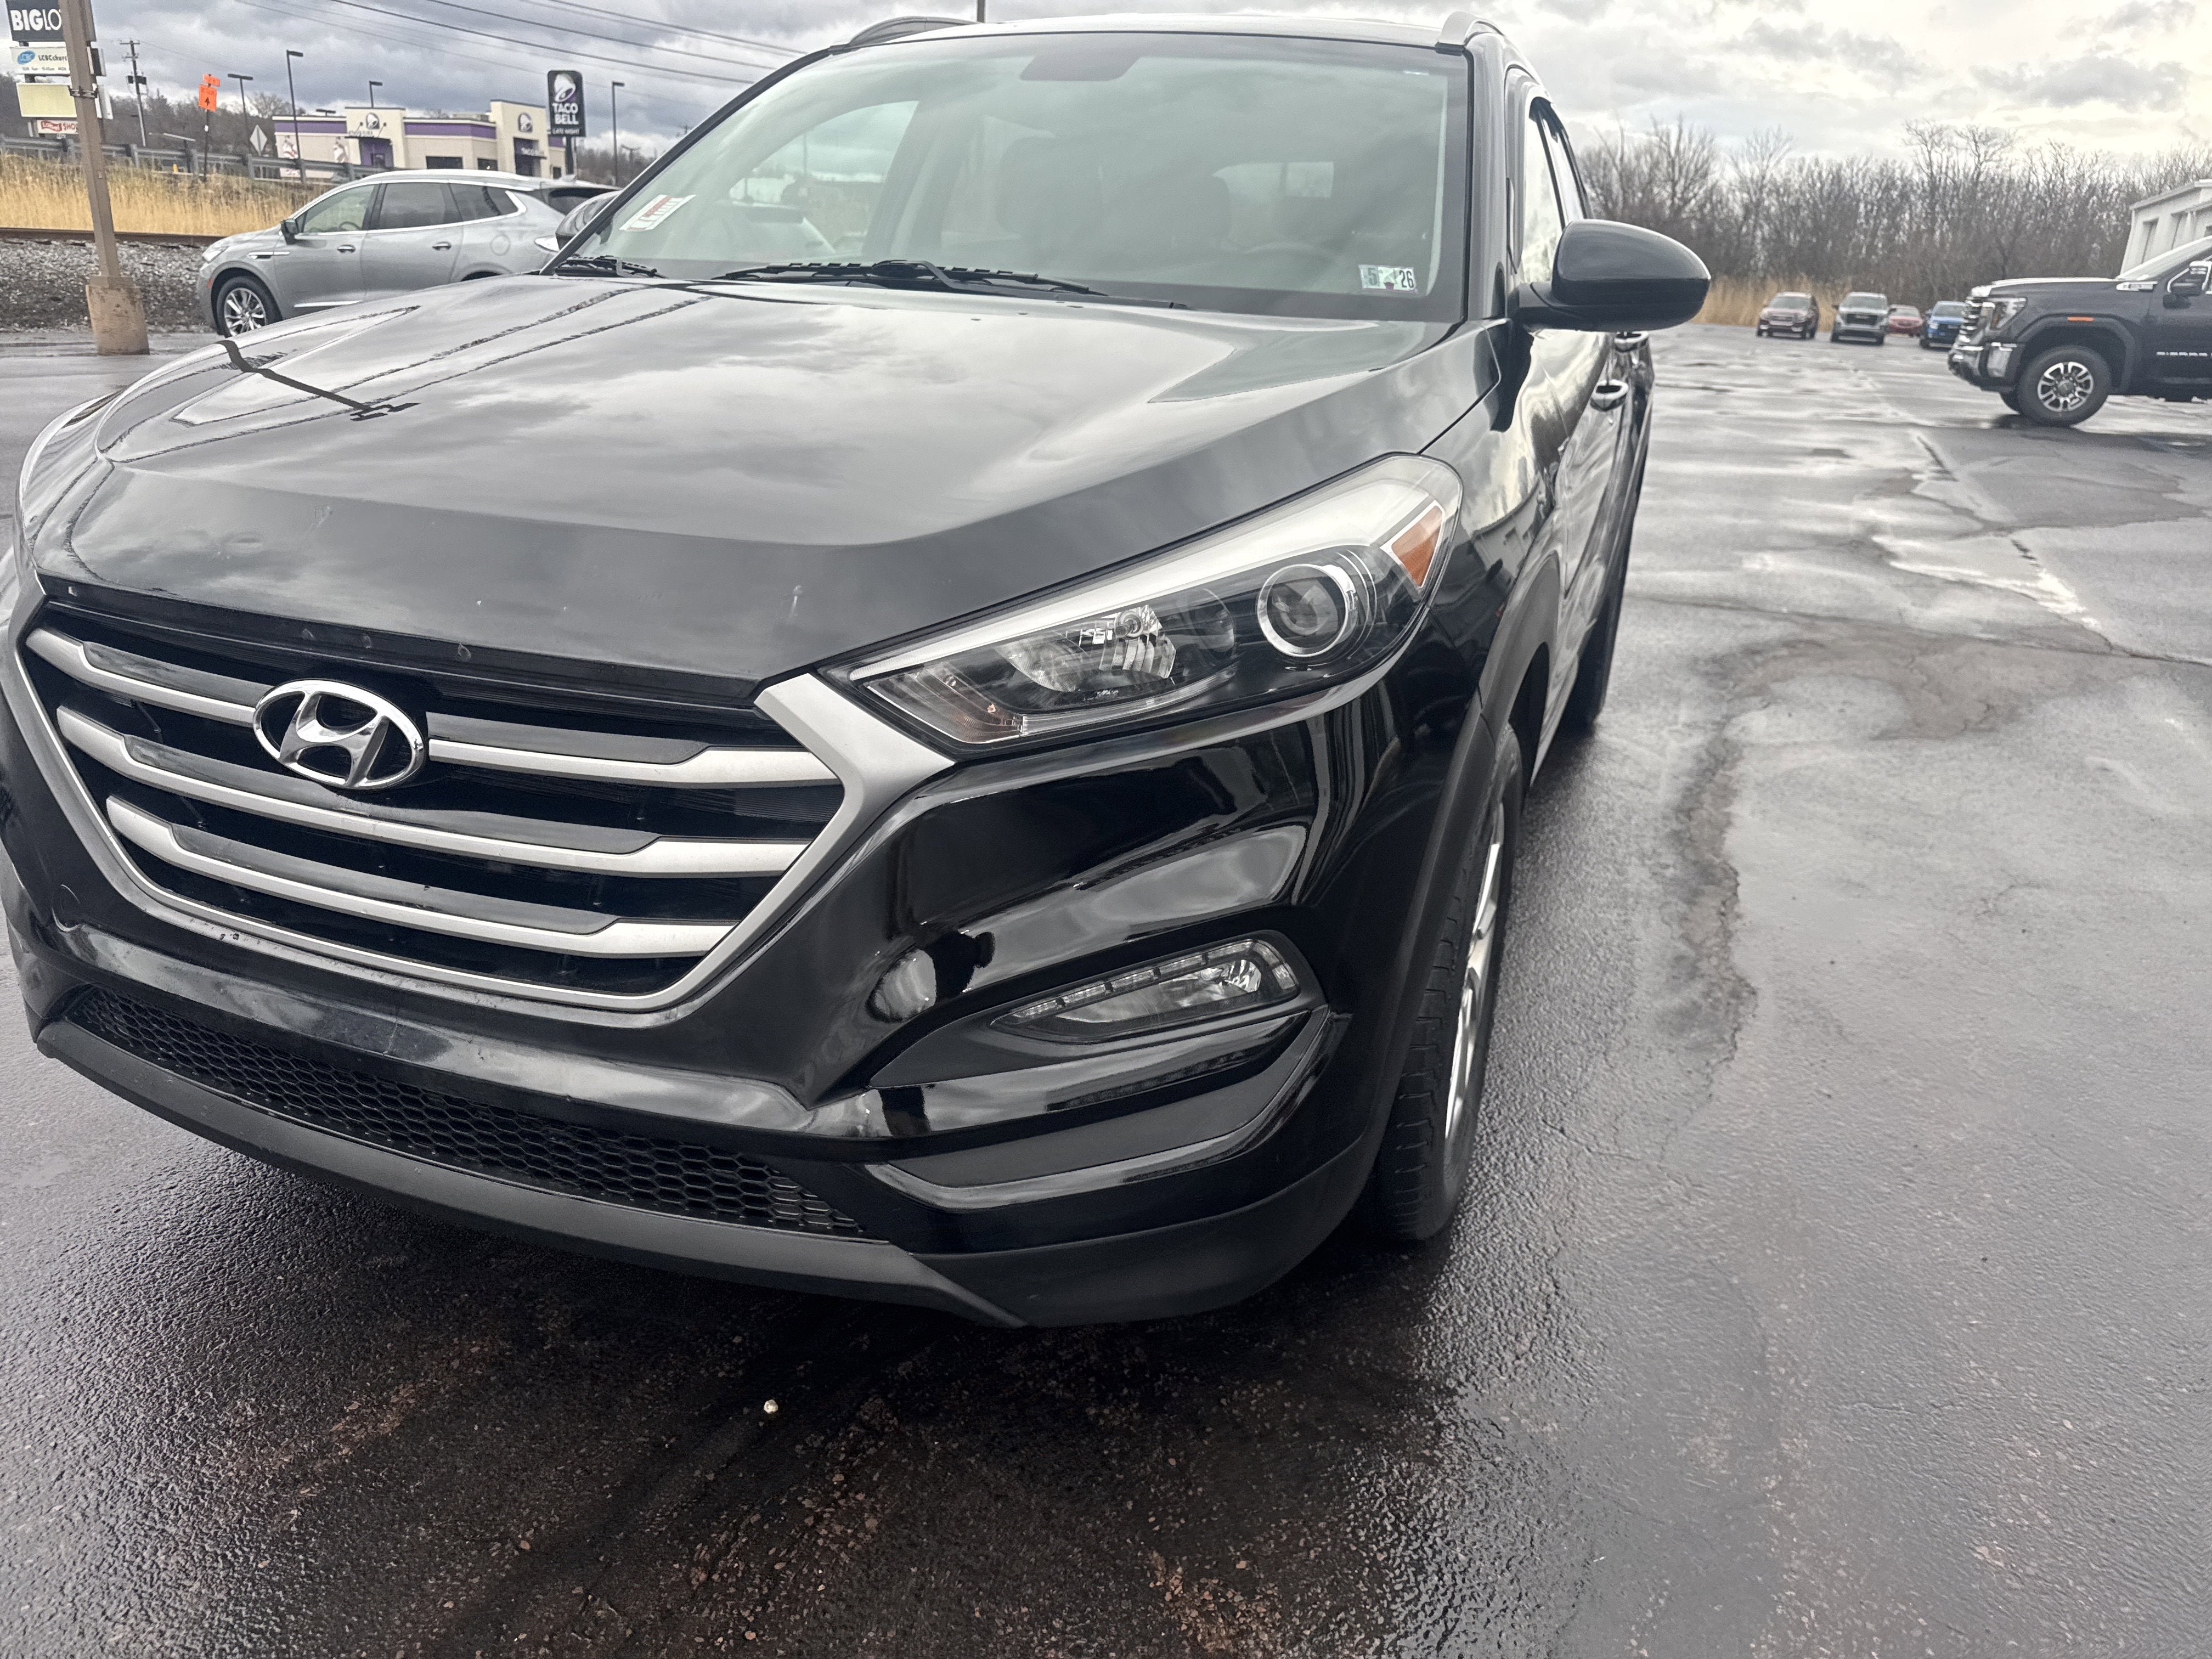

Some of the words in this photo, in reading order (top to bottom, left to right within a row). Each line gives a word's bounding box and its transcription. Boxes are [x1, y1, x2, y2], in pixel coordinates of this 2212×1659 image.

[10, 9, 62, 31] BIGLO
[551, 103, 579, 114] TACO
[554, 114, 579, 125] BELL
[1367, 267, 1378, 285] 5
[1399, 270, 1414, 288] 26
